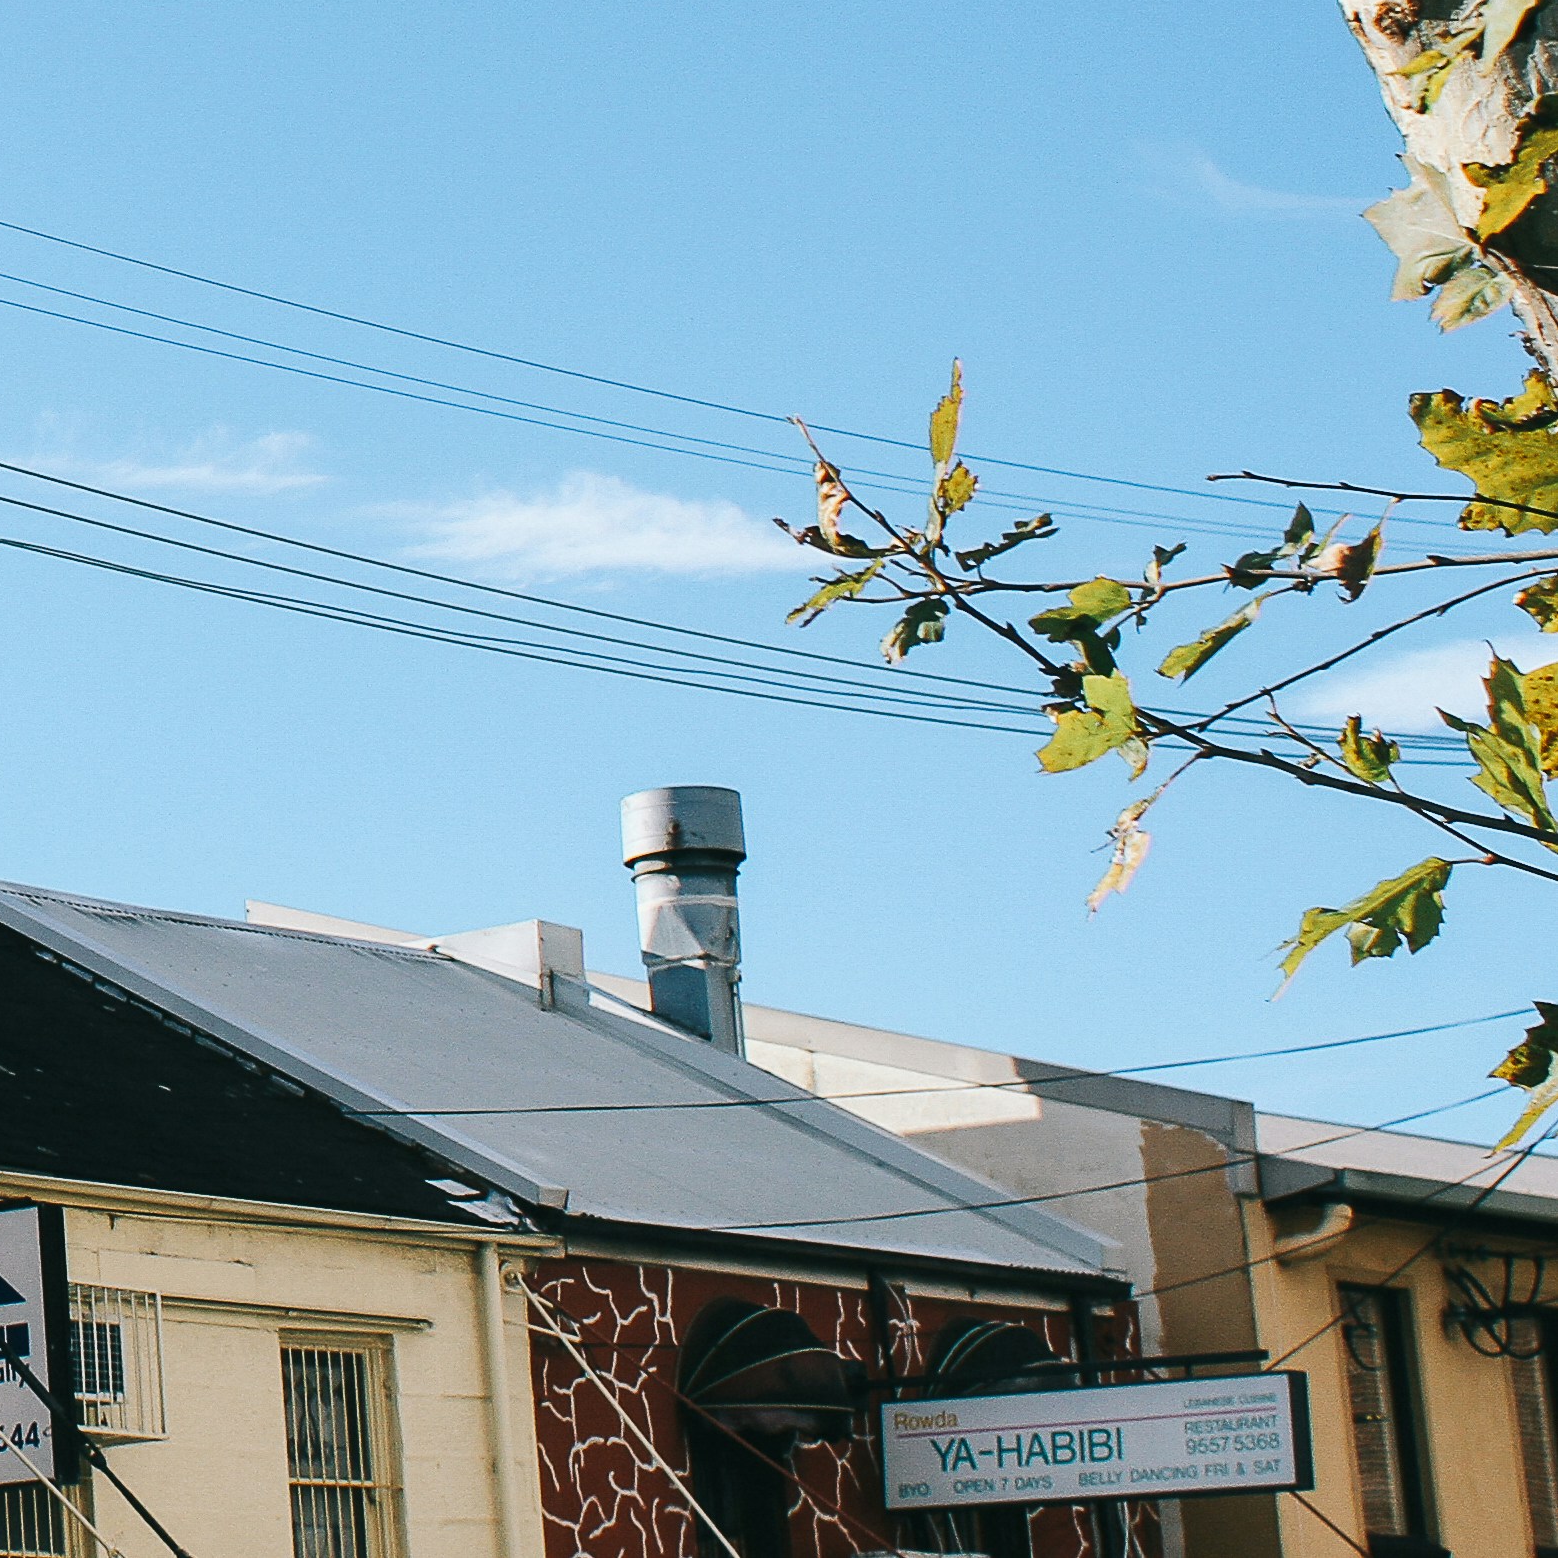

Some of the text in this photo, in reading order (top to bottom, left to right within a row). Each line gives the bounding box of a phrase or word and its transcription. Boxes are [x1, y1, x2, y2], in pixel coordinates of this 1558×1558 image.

[893, 1411, 958, 1430] Rowda
[1185, 1414, 1279, 1434] RESTAURANT
[929, 1427, 1124, 1472] YA-HABIBI
[1186, 1432, 1280, 1455] 9557 5368
[953, 1478, 996, 1494] OPEN
[1001, 1477, 1009, 1491] 7
[1015, 1475, 1053, 1491] DAYS
[1078, 1471, 1123, 1487] BELLY
[1130, 1465, 1199, 1483] DANCING
[1204, 1462, 1229, 1477] FRI
[1253, 1458, 1281, 1475] SAT
